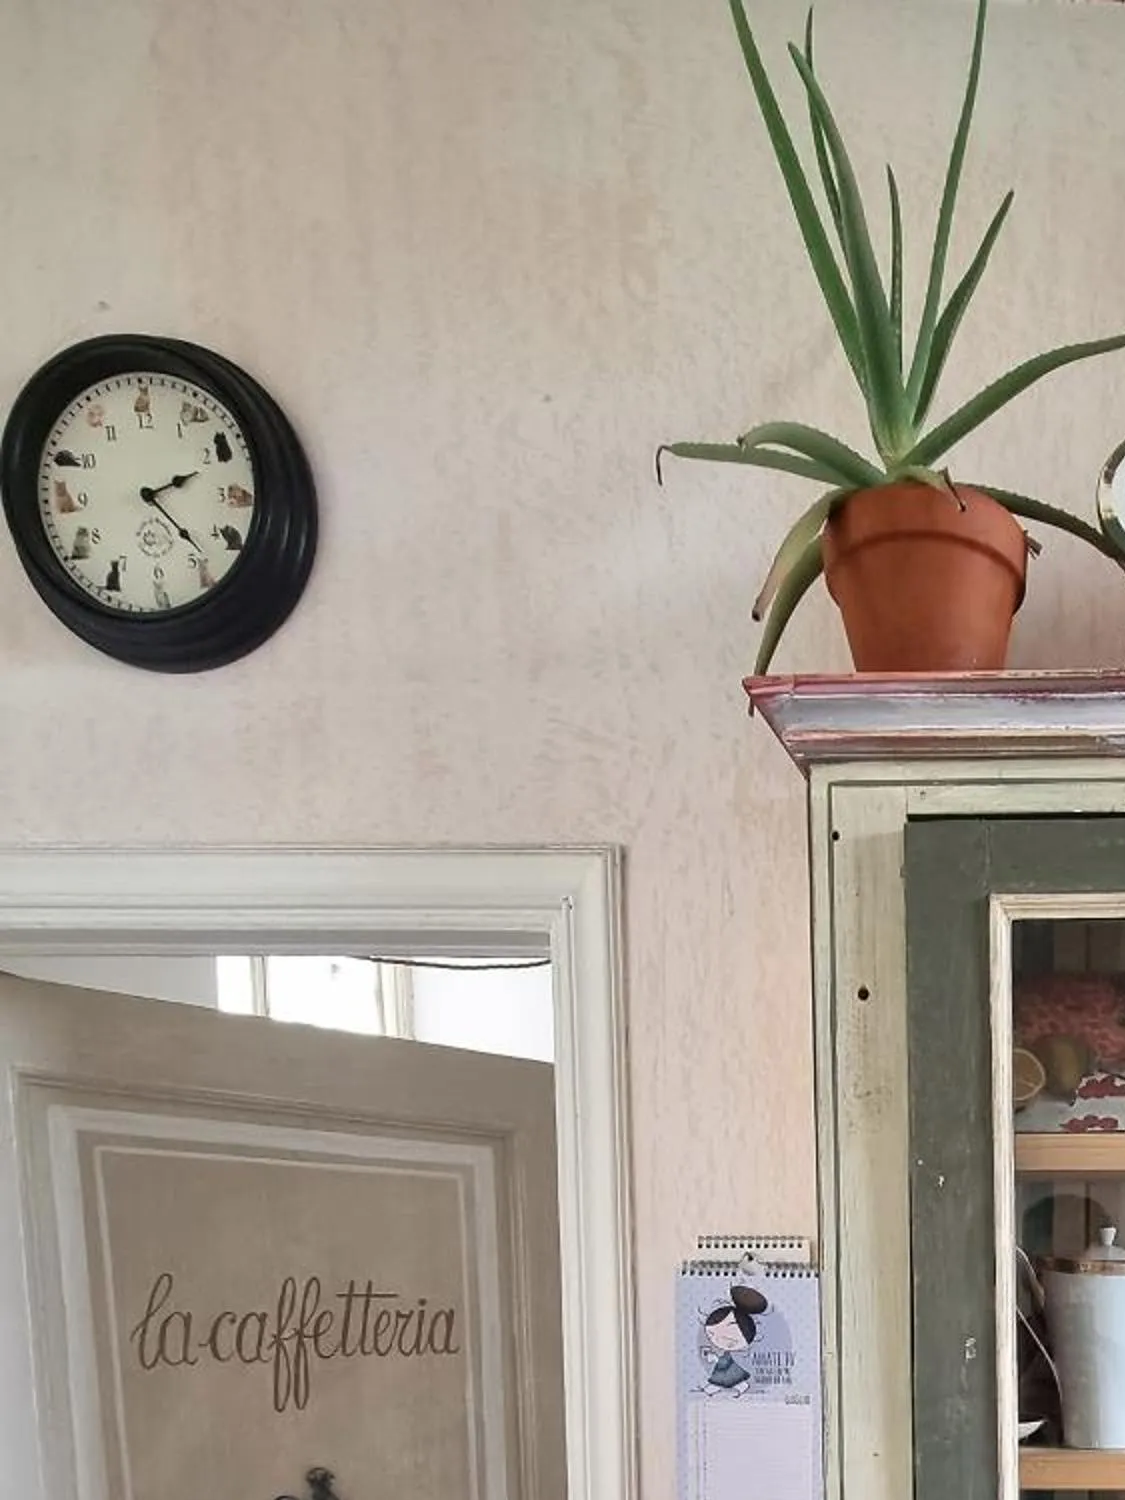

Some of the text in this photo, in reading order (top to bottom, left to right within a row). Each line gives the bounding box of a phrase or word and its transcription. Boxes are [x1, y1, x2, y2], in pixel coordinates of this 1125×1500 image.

[136, 413, 154, 429] 12
[105, 425, 117, 441] 11
[176, 422, 183, 438] 1
[81, 453, 97, 469] 10
[203, 449, 212, 465] 2
[78, 492, 88, 507] 9
[217, 487, 226, 502] 3
[91, 528, 101, 544] 8
[211, 525, 221, 541] 4
[118, 555, 129, 572] 7
[187, 553, 198, 568] 5
[153, 566, 165, 580] 6
